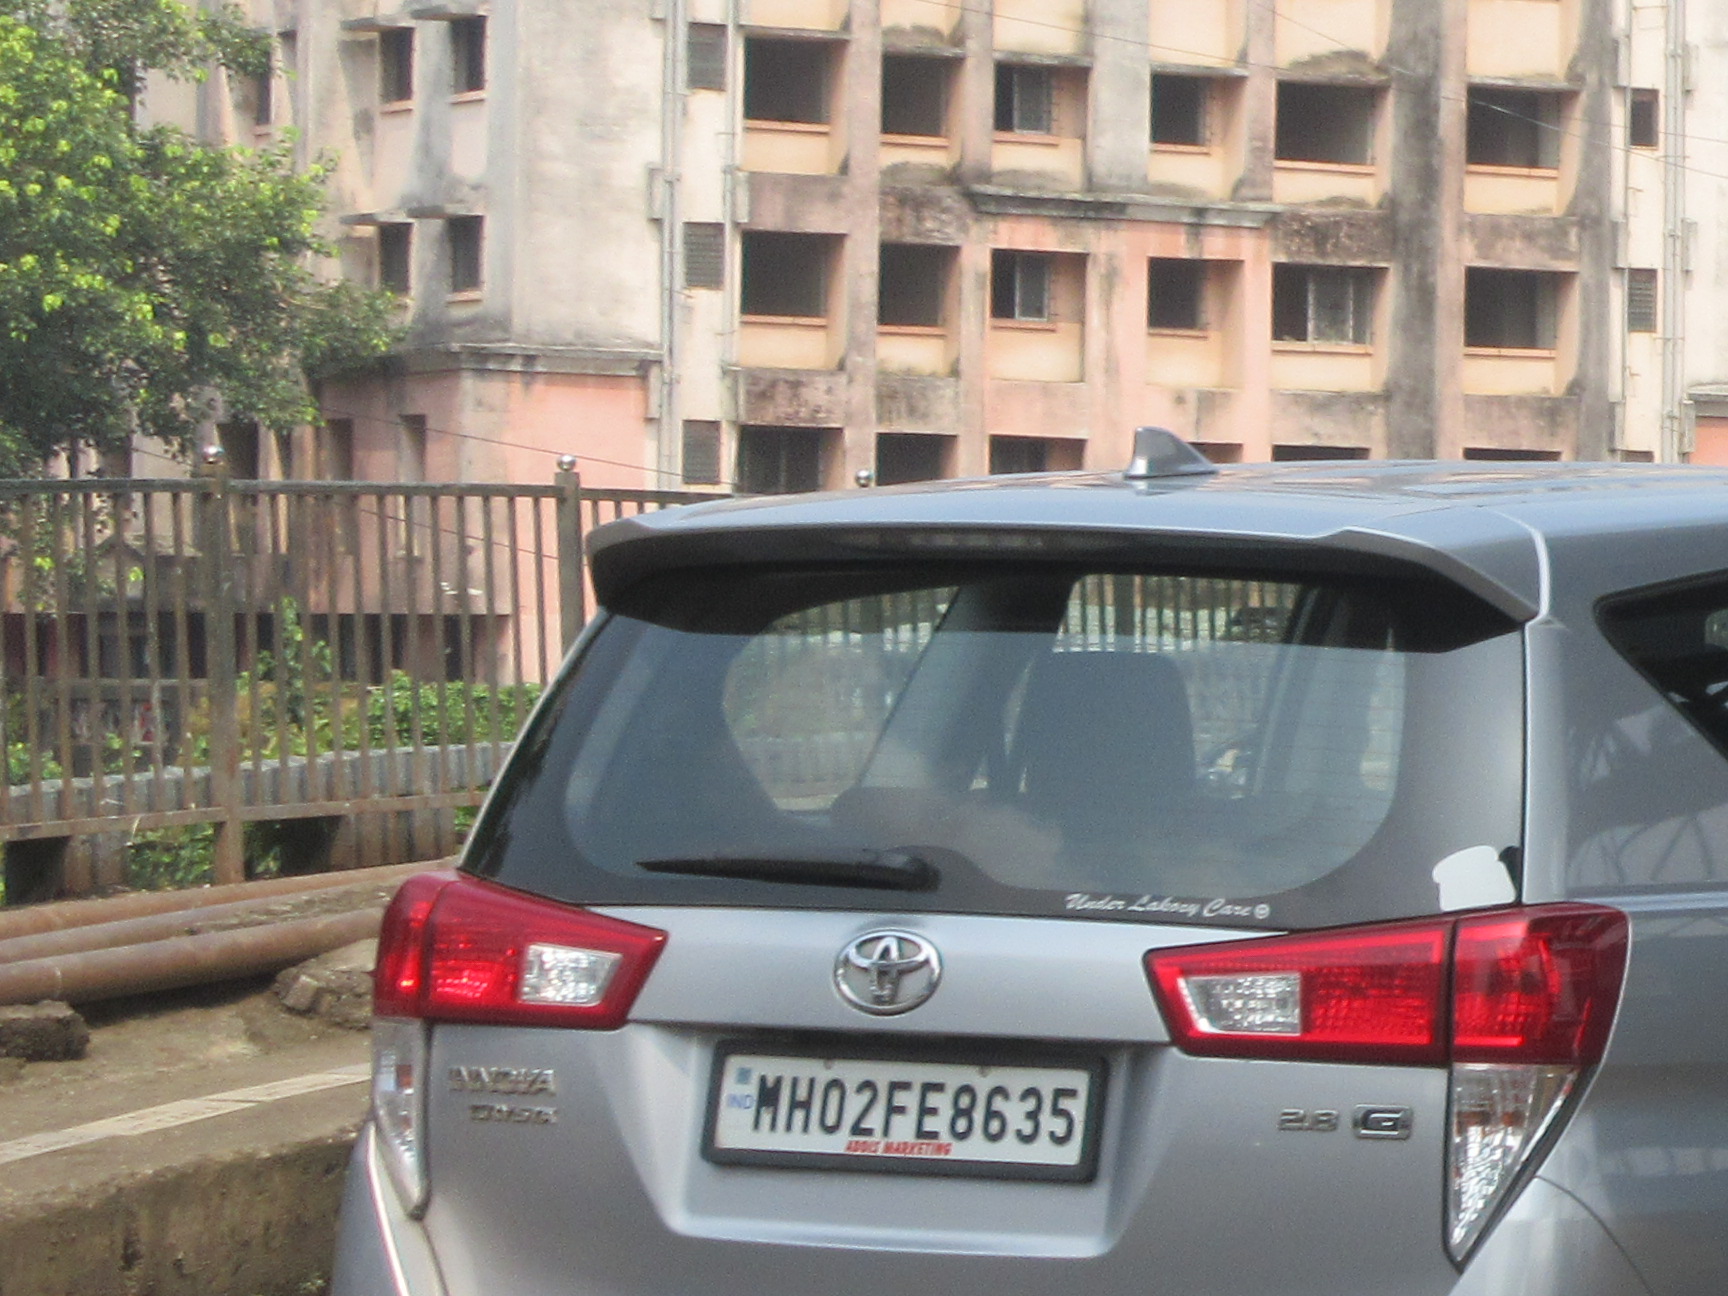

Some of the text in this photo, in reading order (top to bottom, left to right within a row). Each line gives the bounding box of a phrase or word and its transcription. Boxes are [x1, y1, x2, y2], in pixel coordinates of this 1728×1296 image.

[1065, 892, 1126, 912] Under
[1202, 898, 1252, 918] Care
[752, 1073, 1079, 1147] MH02FE8635
